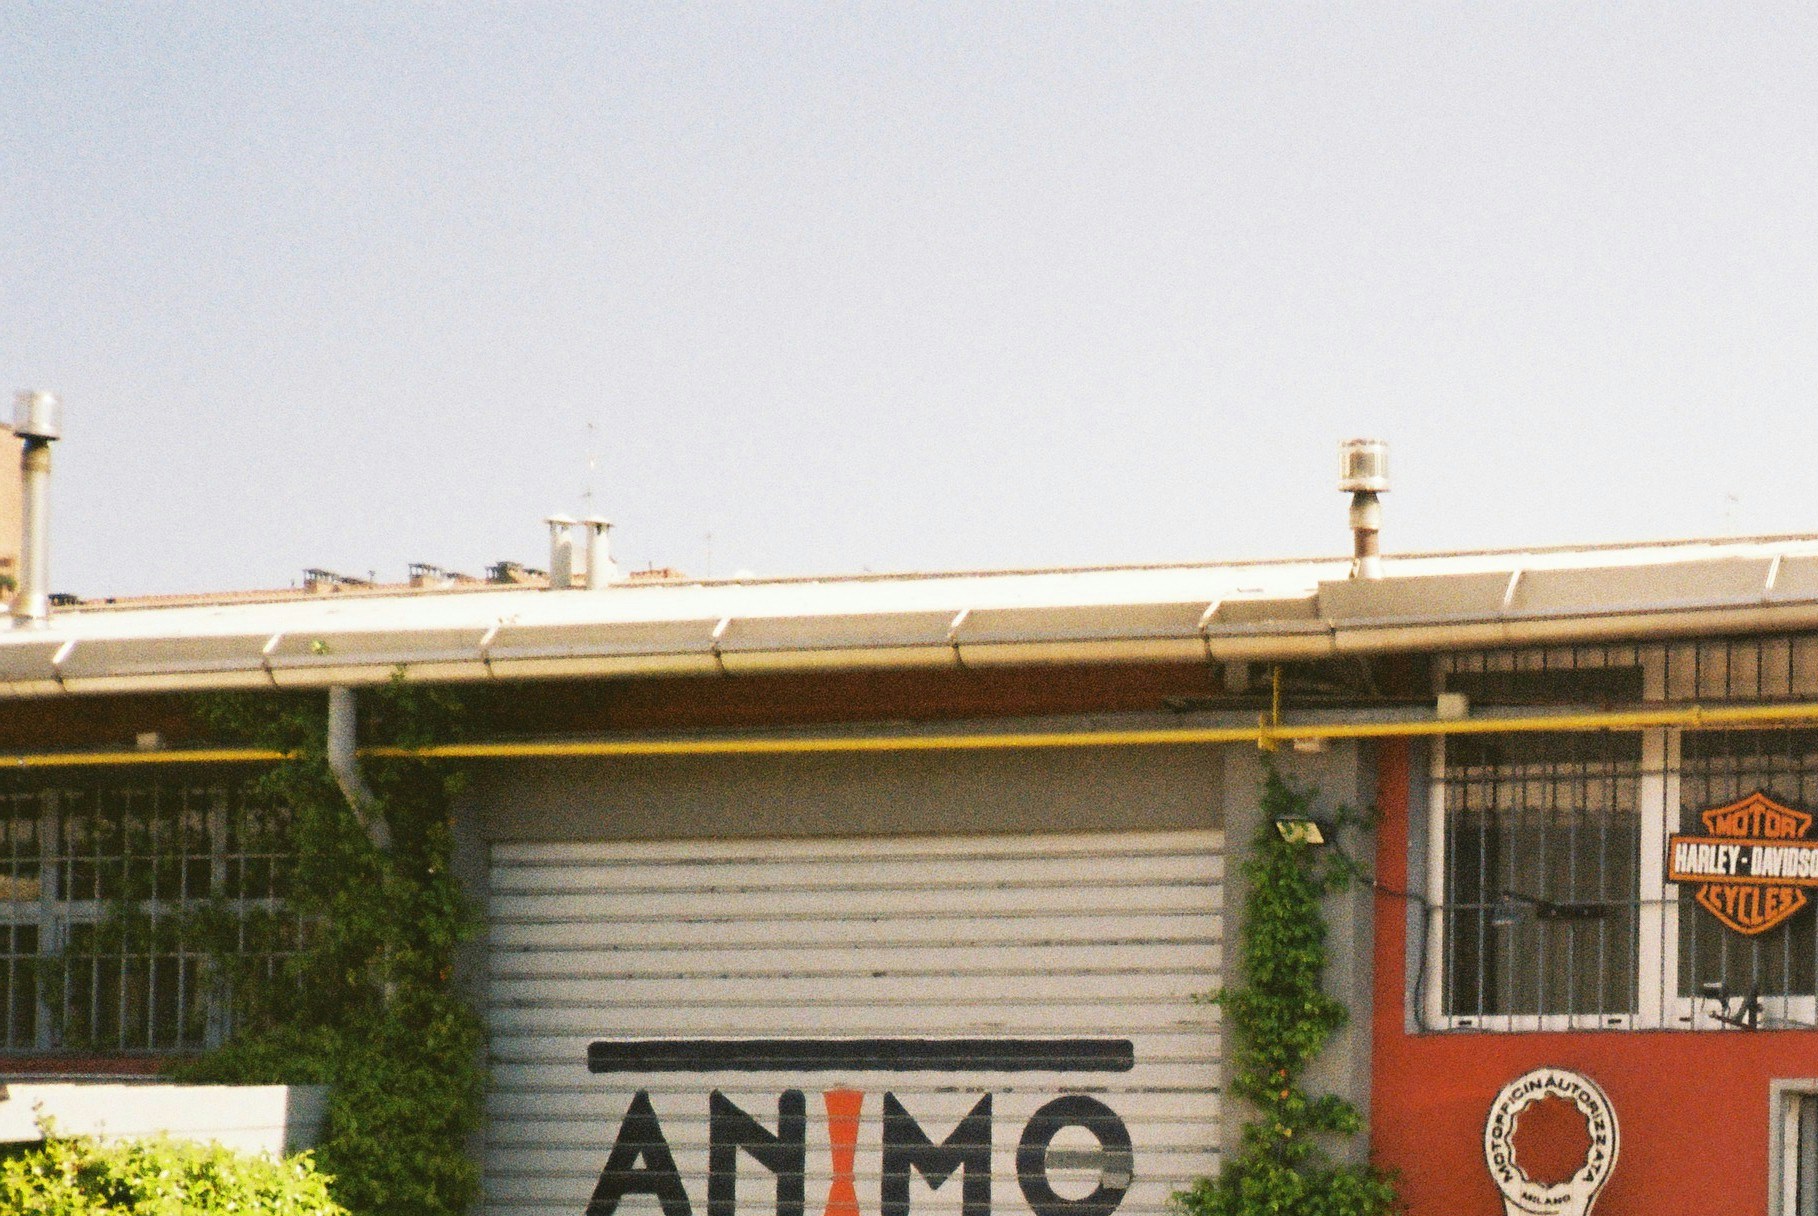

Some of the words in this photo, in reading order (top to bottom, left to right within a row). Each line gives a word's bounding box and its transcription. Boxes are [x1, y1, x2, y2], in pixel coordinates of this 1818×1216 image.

[1712, 804, 1798, 838] MOTOR
[1708, 885, 1795, 926] CYCLES
[1521, 1191, 1572, 1206] MILANO
